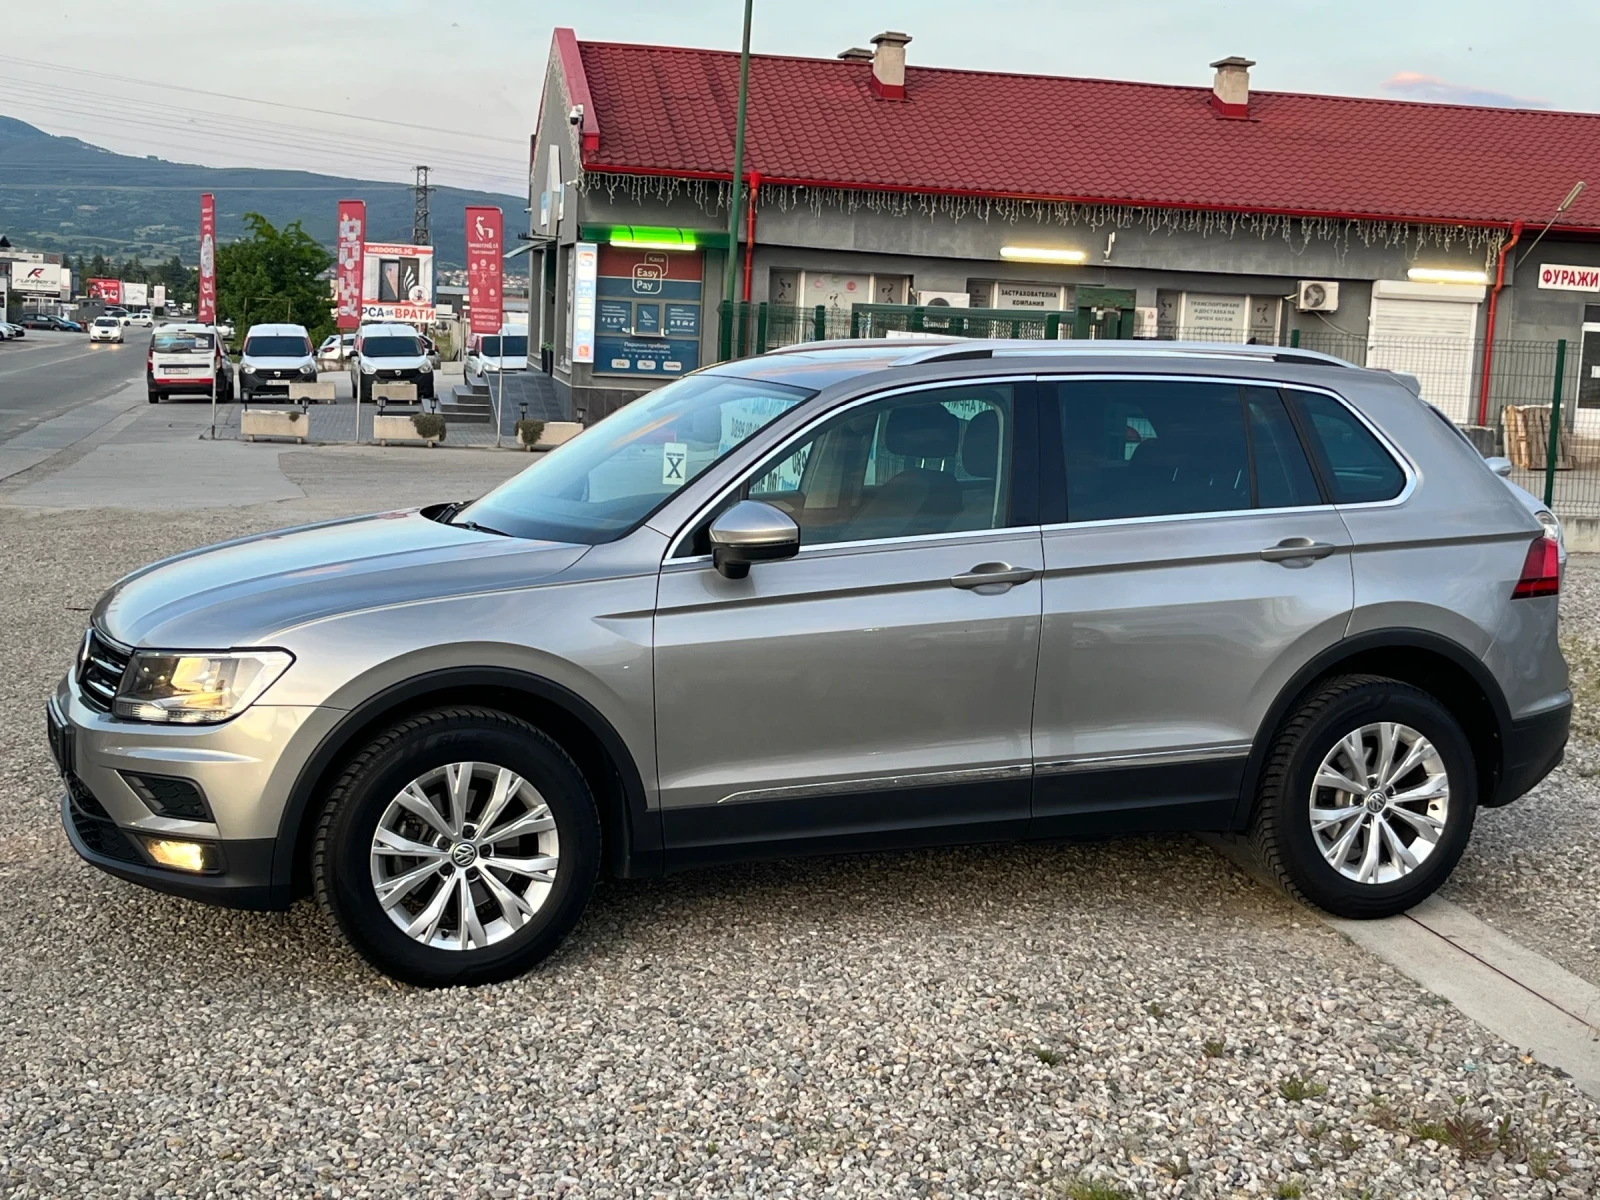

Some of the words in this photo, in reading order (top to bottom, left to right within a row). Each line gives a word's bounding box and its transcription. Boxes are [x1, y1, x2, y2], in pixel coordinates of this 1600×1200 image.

[637, 267, 659, 279] Easy
[1542, 269, 1599, 287] ФУРАЖИ
[636, 279, 653, 291] Pay
[1001, 289, 1058, 298] ЗАСТРАХОВАТЕЛНА
[1012, 299, 1045, 307] КОМПАНИЯ
[394, 308, 435, 320] ВРАТИ
